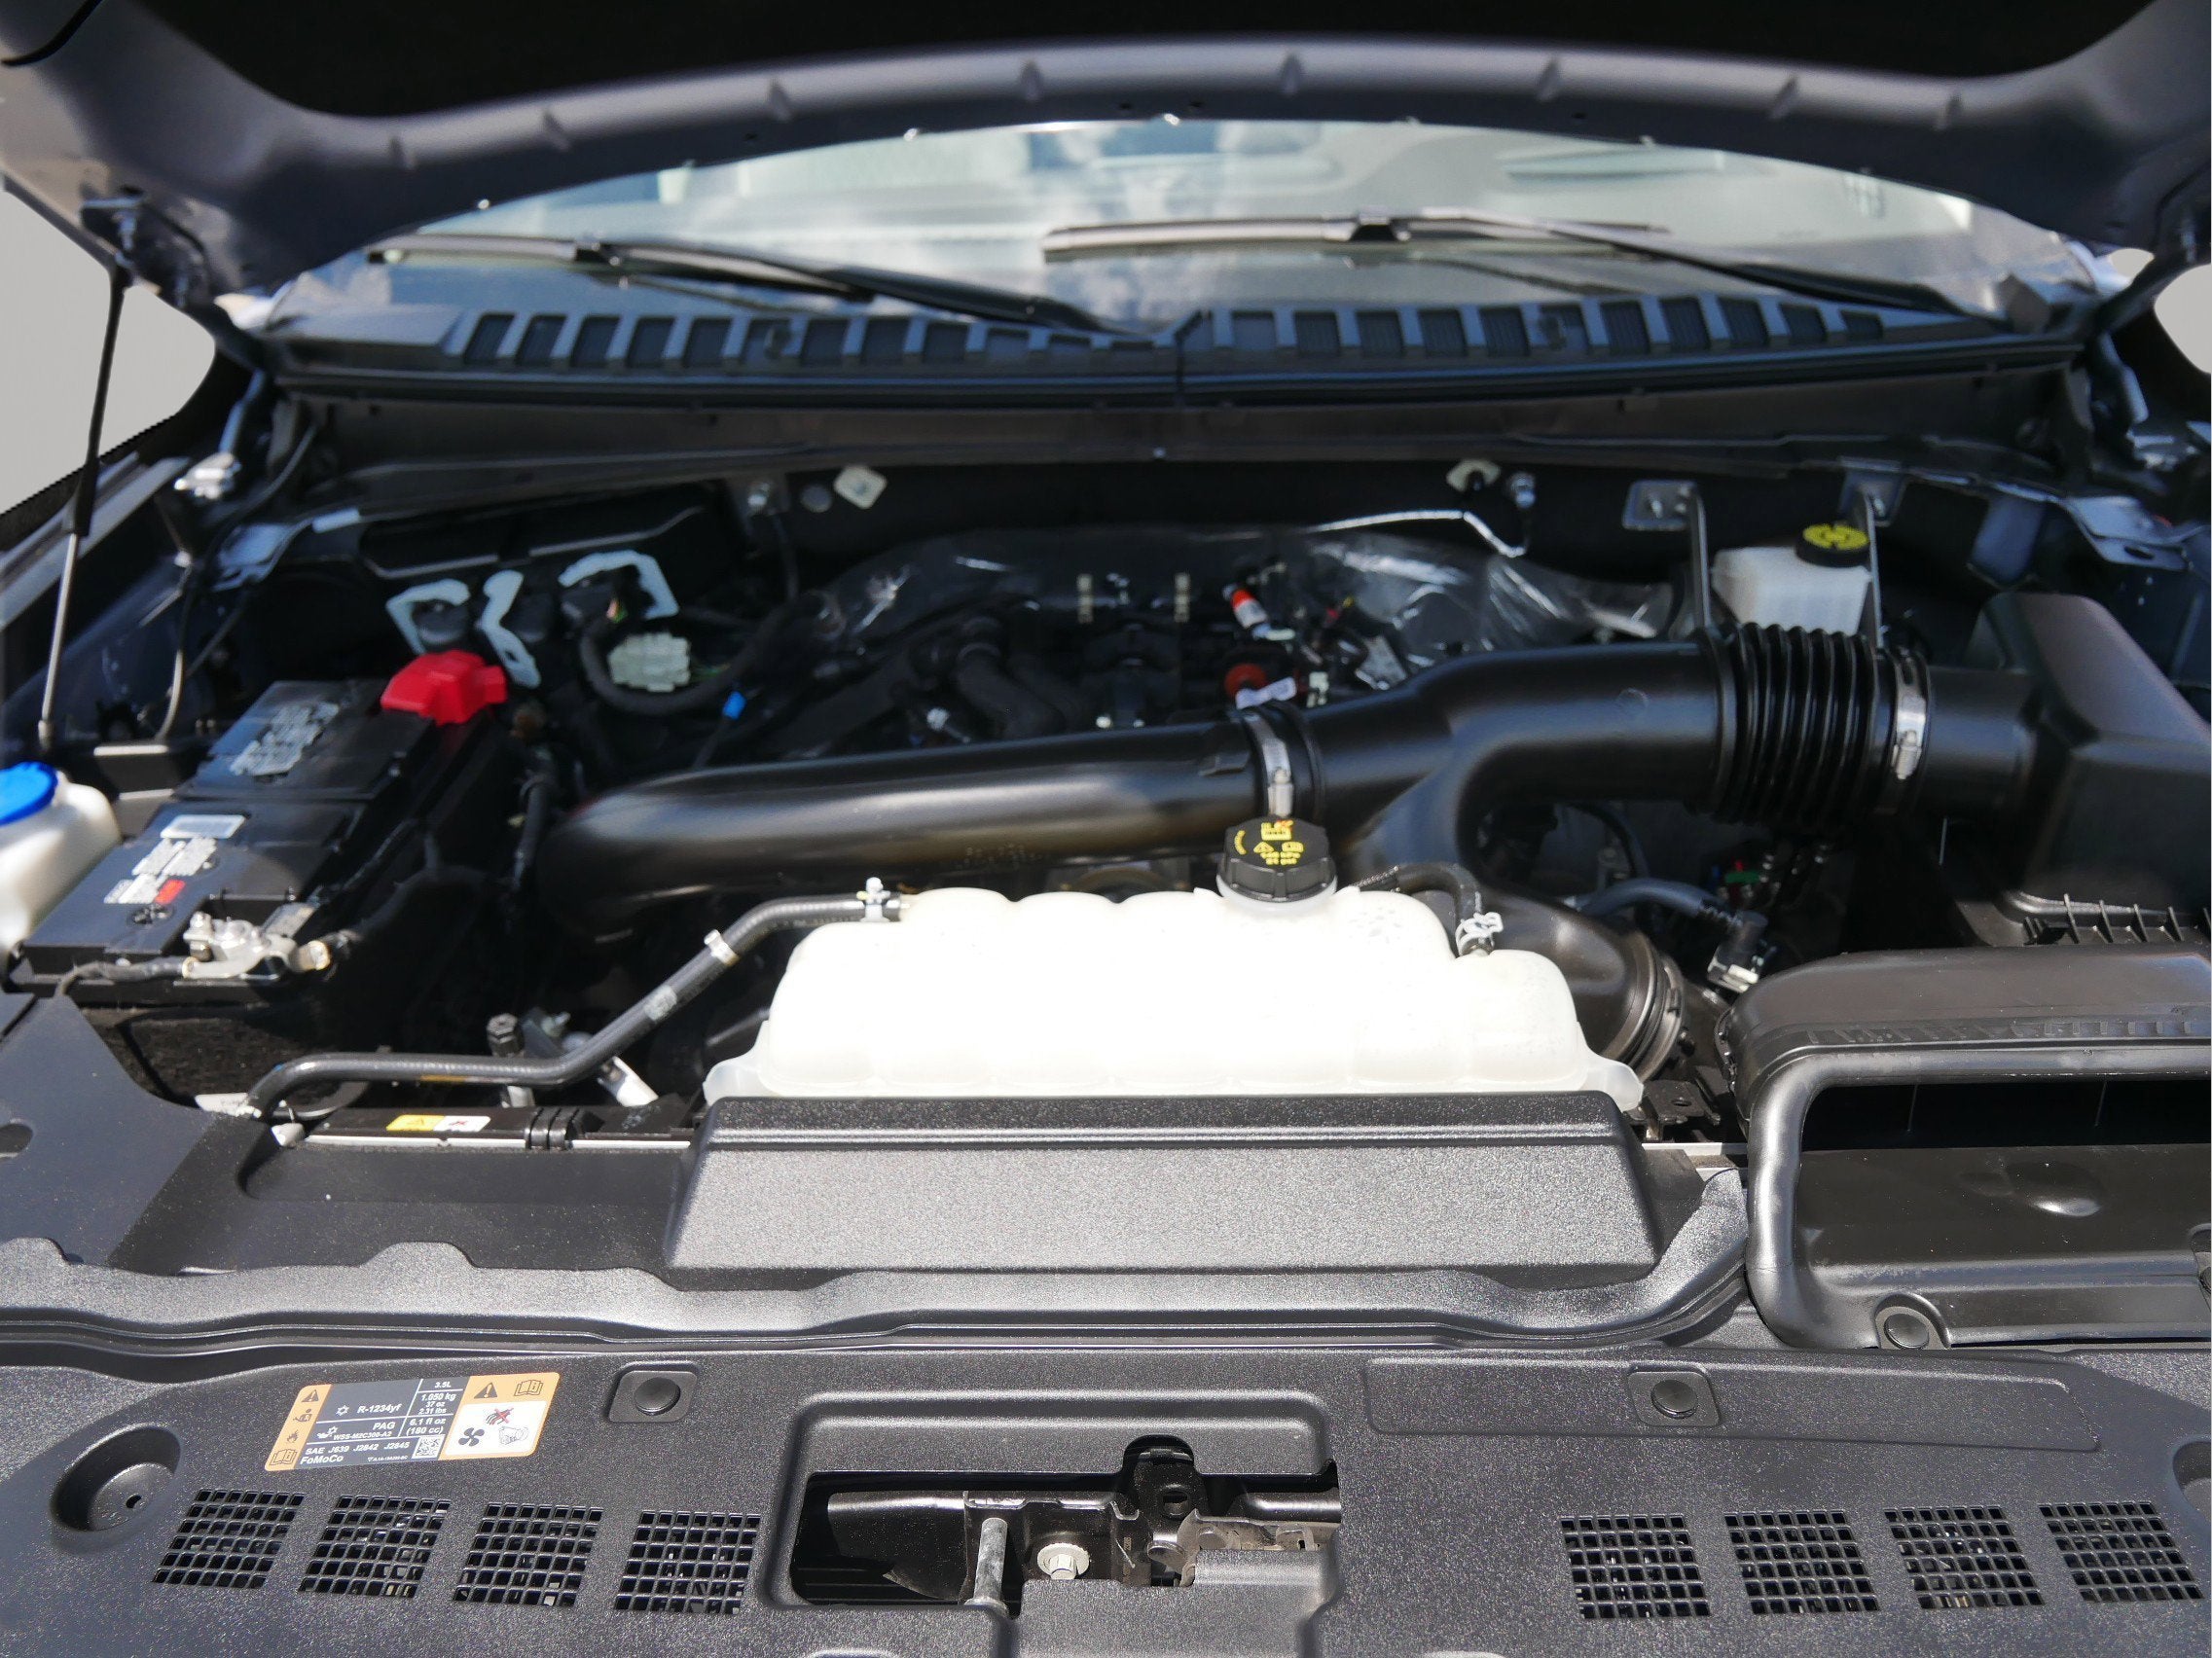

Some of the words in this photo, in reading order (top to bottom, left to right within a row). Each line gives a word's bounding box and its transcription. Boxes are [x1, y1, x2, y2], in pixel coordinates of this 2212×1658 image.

[445, 1392, 456, 1402] kg
[356, 1403, 402, 1414] R-1234yf
[372, 1422, 396, 1430] PAG
[425, 1417, 433, 1425] fl
[428, 1425, 444, 1435] cc)
[305, 1447, 325, 1456] SAE
[300, 1454, 344, 1465] FoMoCo
